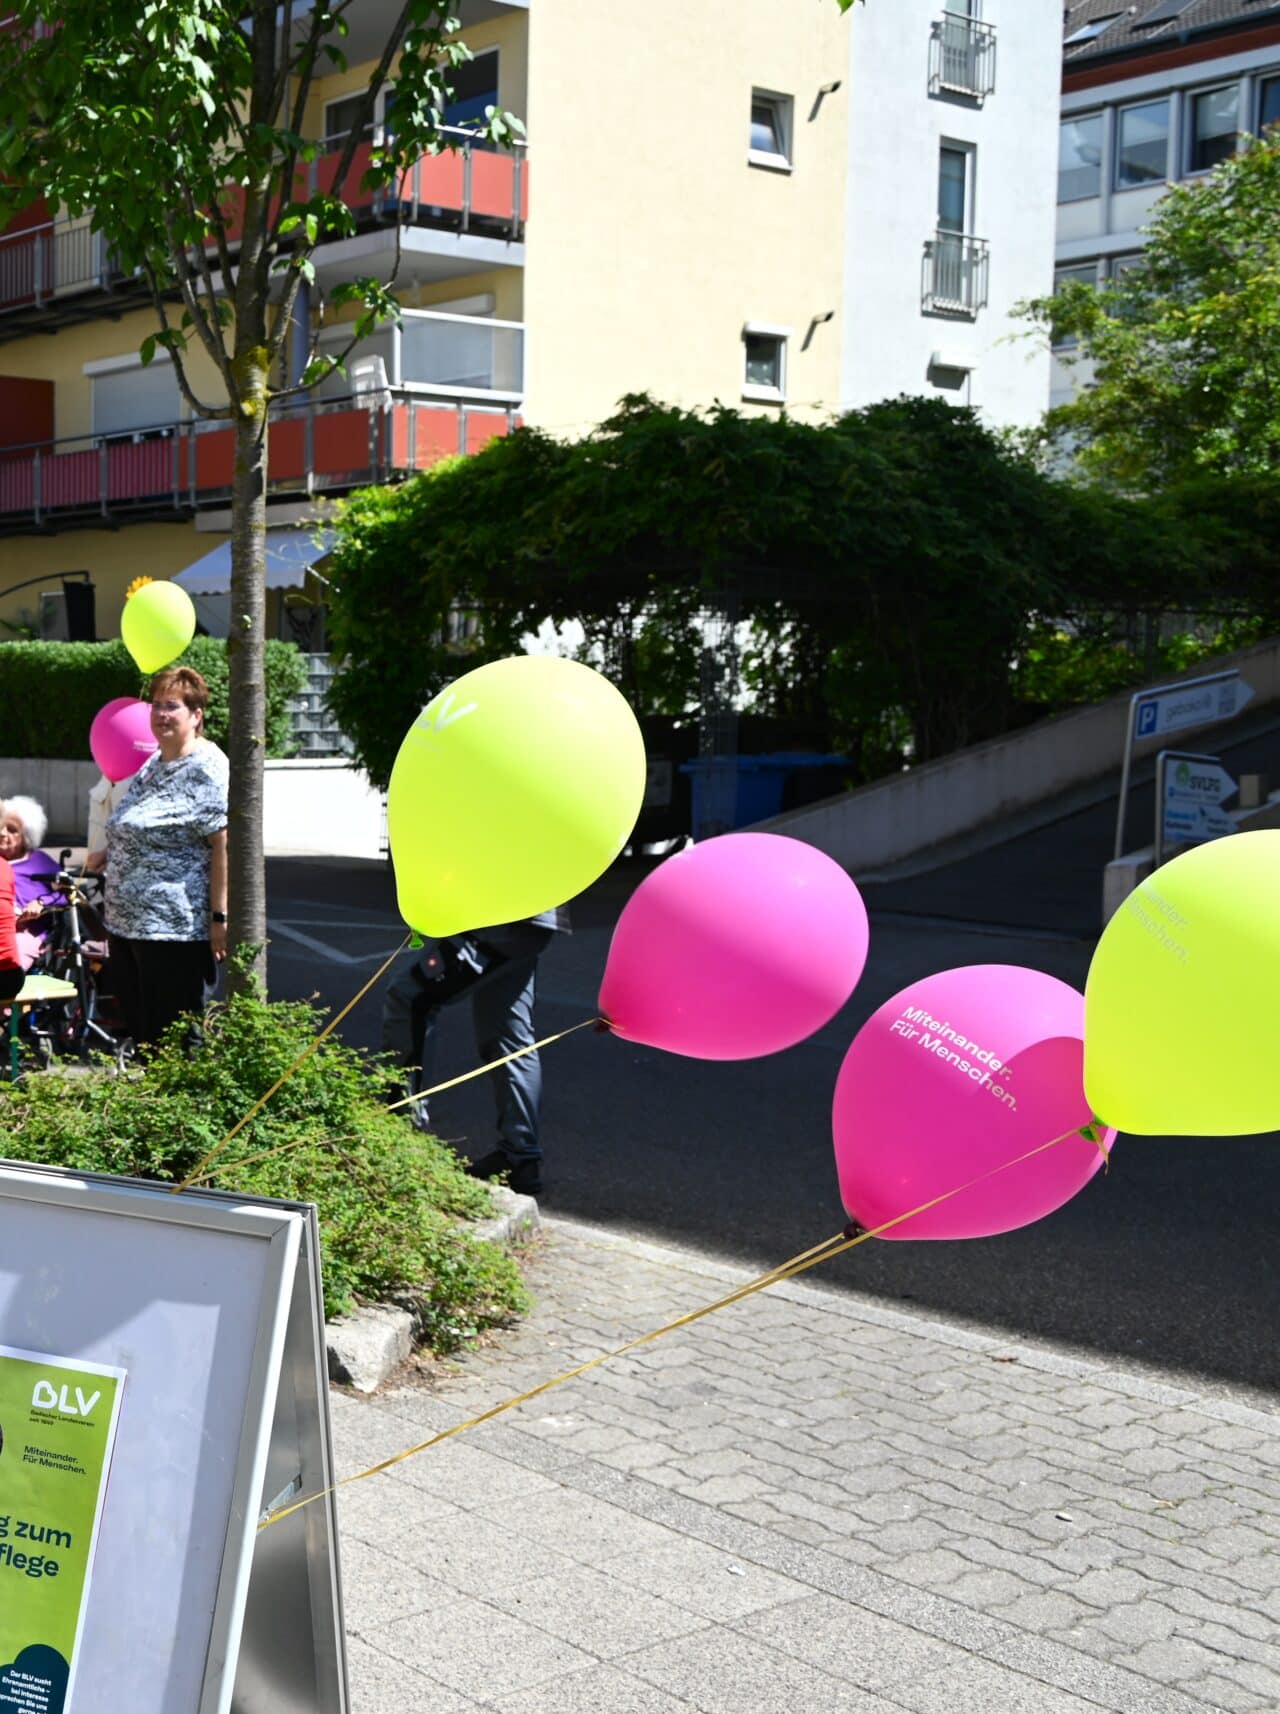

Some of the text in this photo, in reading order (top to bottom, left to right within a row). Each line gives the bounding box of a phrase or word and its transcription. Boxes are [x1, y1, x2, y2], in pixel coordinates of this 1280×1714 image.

[1141, 705, 1157, 732] P
[902, 1006, 1012, 1080] Miteinander.
[889, 1020, 1017, 1112] Für Menschen.
[31, 1380, 100, 1416] BLV
[23, 1454, 87, 1474] Für Menschen.
[24, 1445, 79, 1464] Miteinander.
[14, 1520, 71, 1548] zum
